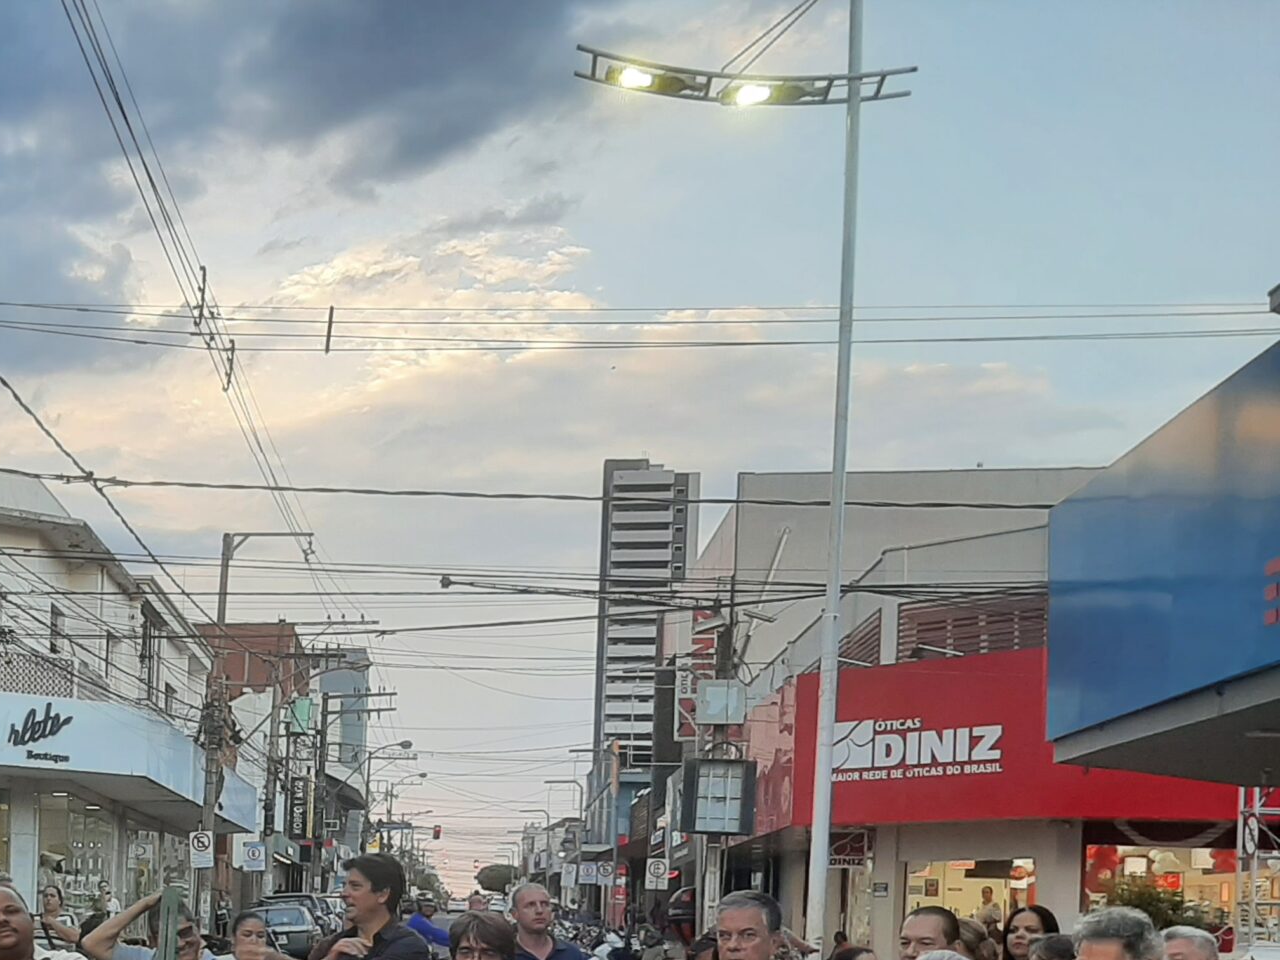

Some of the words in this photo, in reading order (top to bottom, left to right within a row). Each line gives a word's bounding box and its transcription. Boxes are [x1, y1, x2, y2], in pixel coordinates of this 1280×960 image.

[875, 717, 922, 731] ÓTICAS
[873, 725, 1004, 768] DINIZ
[26, 749, 71, 764] Boutique
[862, 770, 888, 780] REDE
[890, 768, 903, 779] DE
[906, 765, 943, 778] ÓTICAS
[946, 765, 961, 775] DO
[964, 763, 1003, 774] BRASIL
[829, 857, 864, 866] DINIZ
